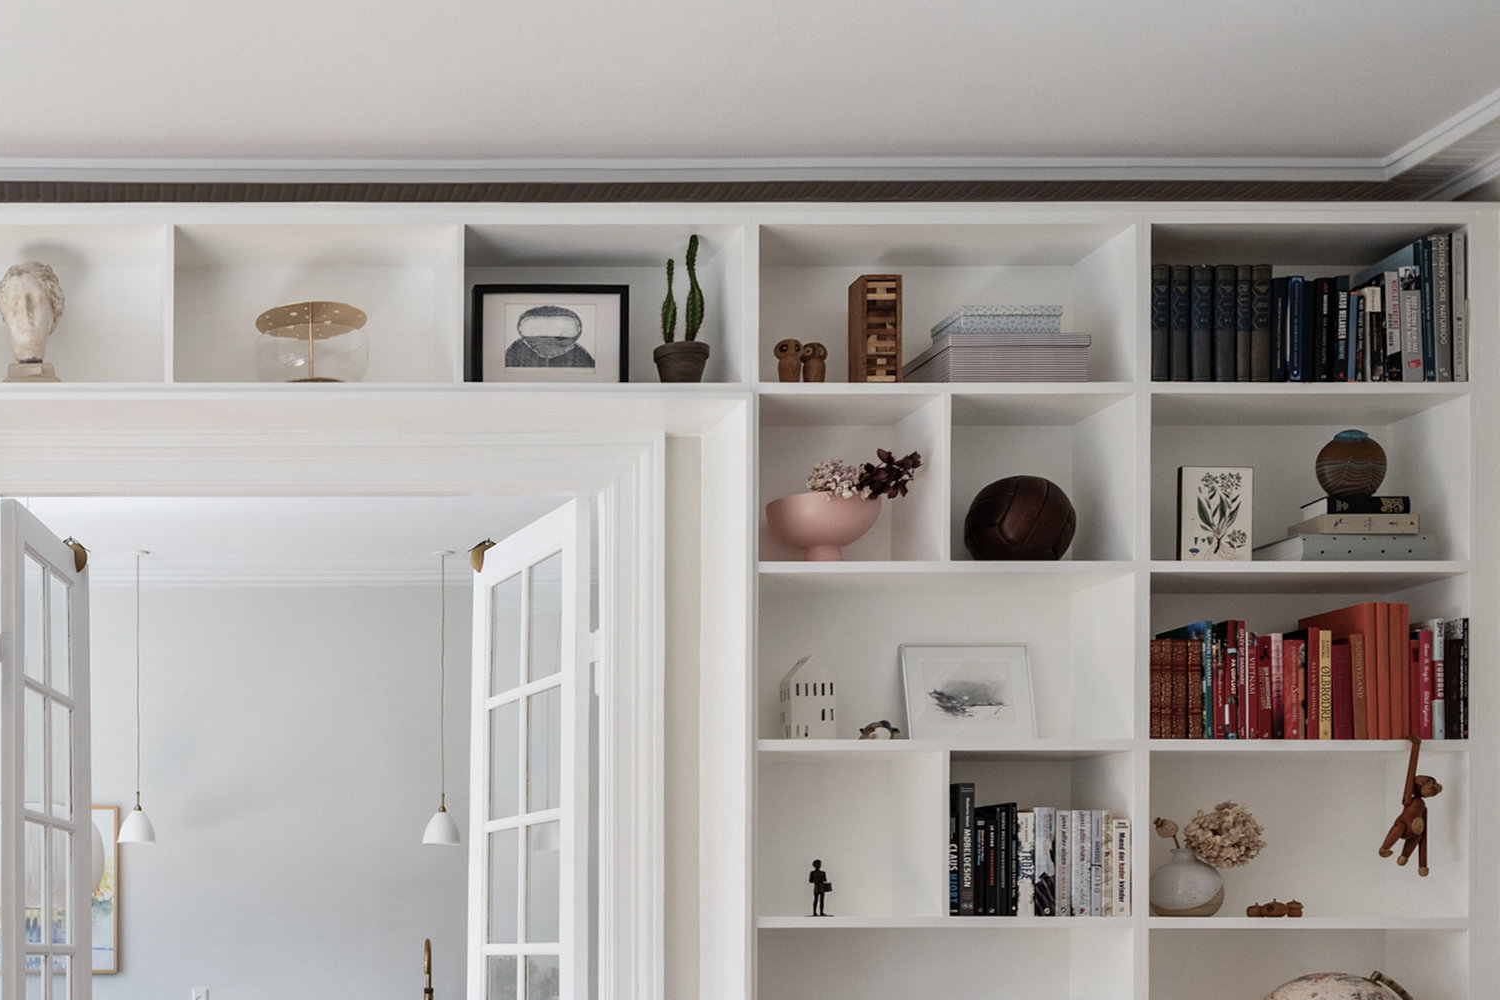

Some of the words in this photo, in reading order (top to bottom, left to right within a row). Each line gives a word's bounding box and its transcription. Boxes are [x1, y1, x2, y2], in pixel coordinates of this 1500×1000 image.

[1438, 237, 1446, 278] POLITIKENS
[1339, 291, 1347, 309] JAKOB
[1438, 280, 1447, 302] STORE
[1338, 309, 1347, 339] MELANDER
[1439, 304, 1447, 345] NATURBOG
[1230, 659, 1237, 667] PÅ
[1354, 641, 1363, 698] NORDJYLLAND
[1320, 665, 1331, 722] ØLBRØDRE
[1436, 663, 1444, 698] FODBOLD
[1059, 814, 1068, 829] jussi
[1078, 812, 1087, 827] jussi
[949, 843, 958, 871] CLAUS
[963, 828, 972, 888] MØBELDESIGN
[1021, 850, 1033, 880] TROFÆ
[949, 874, 958, 904] HJORT
